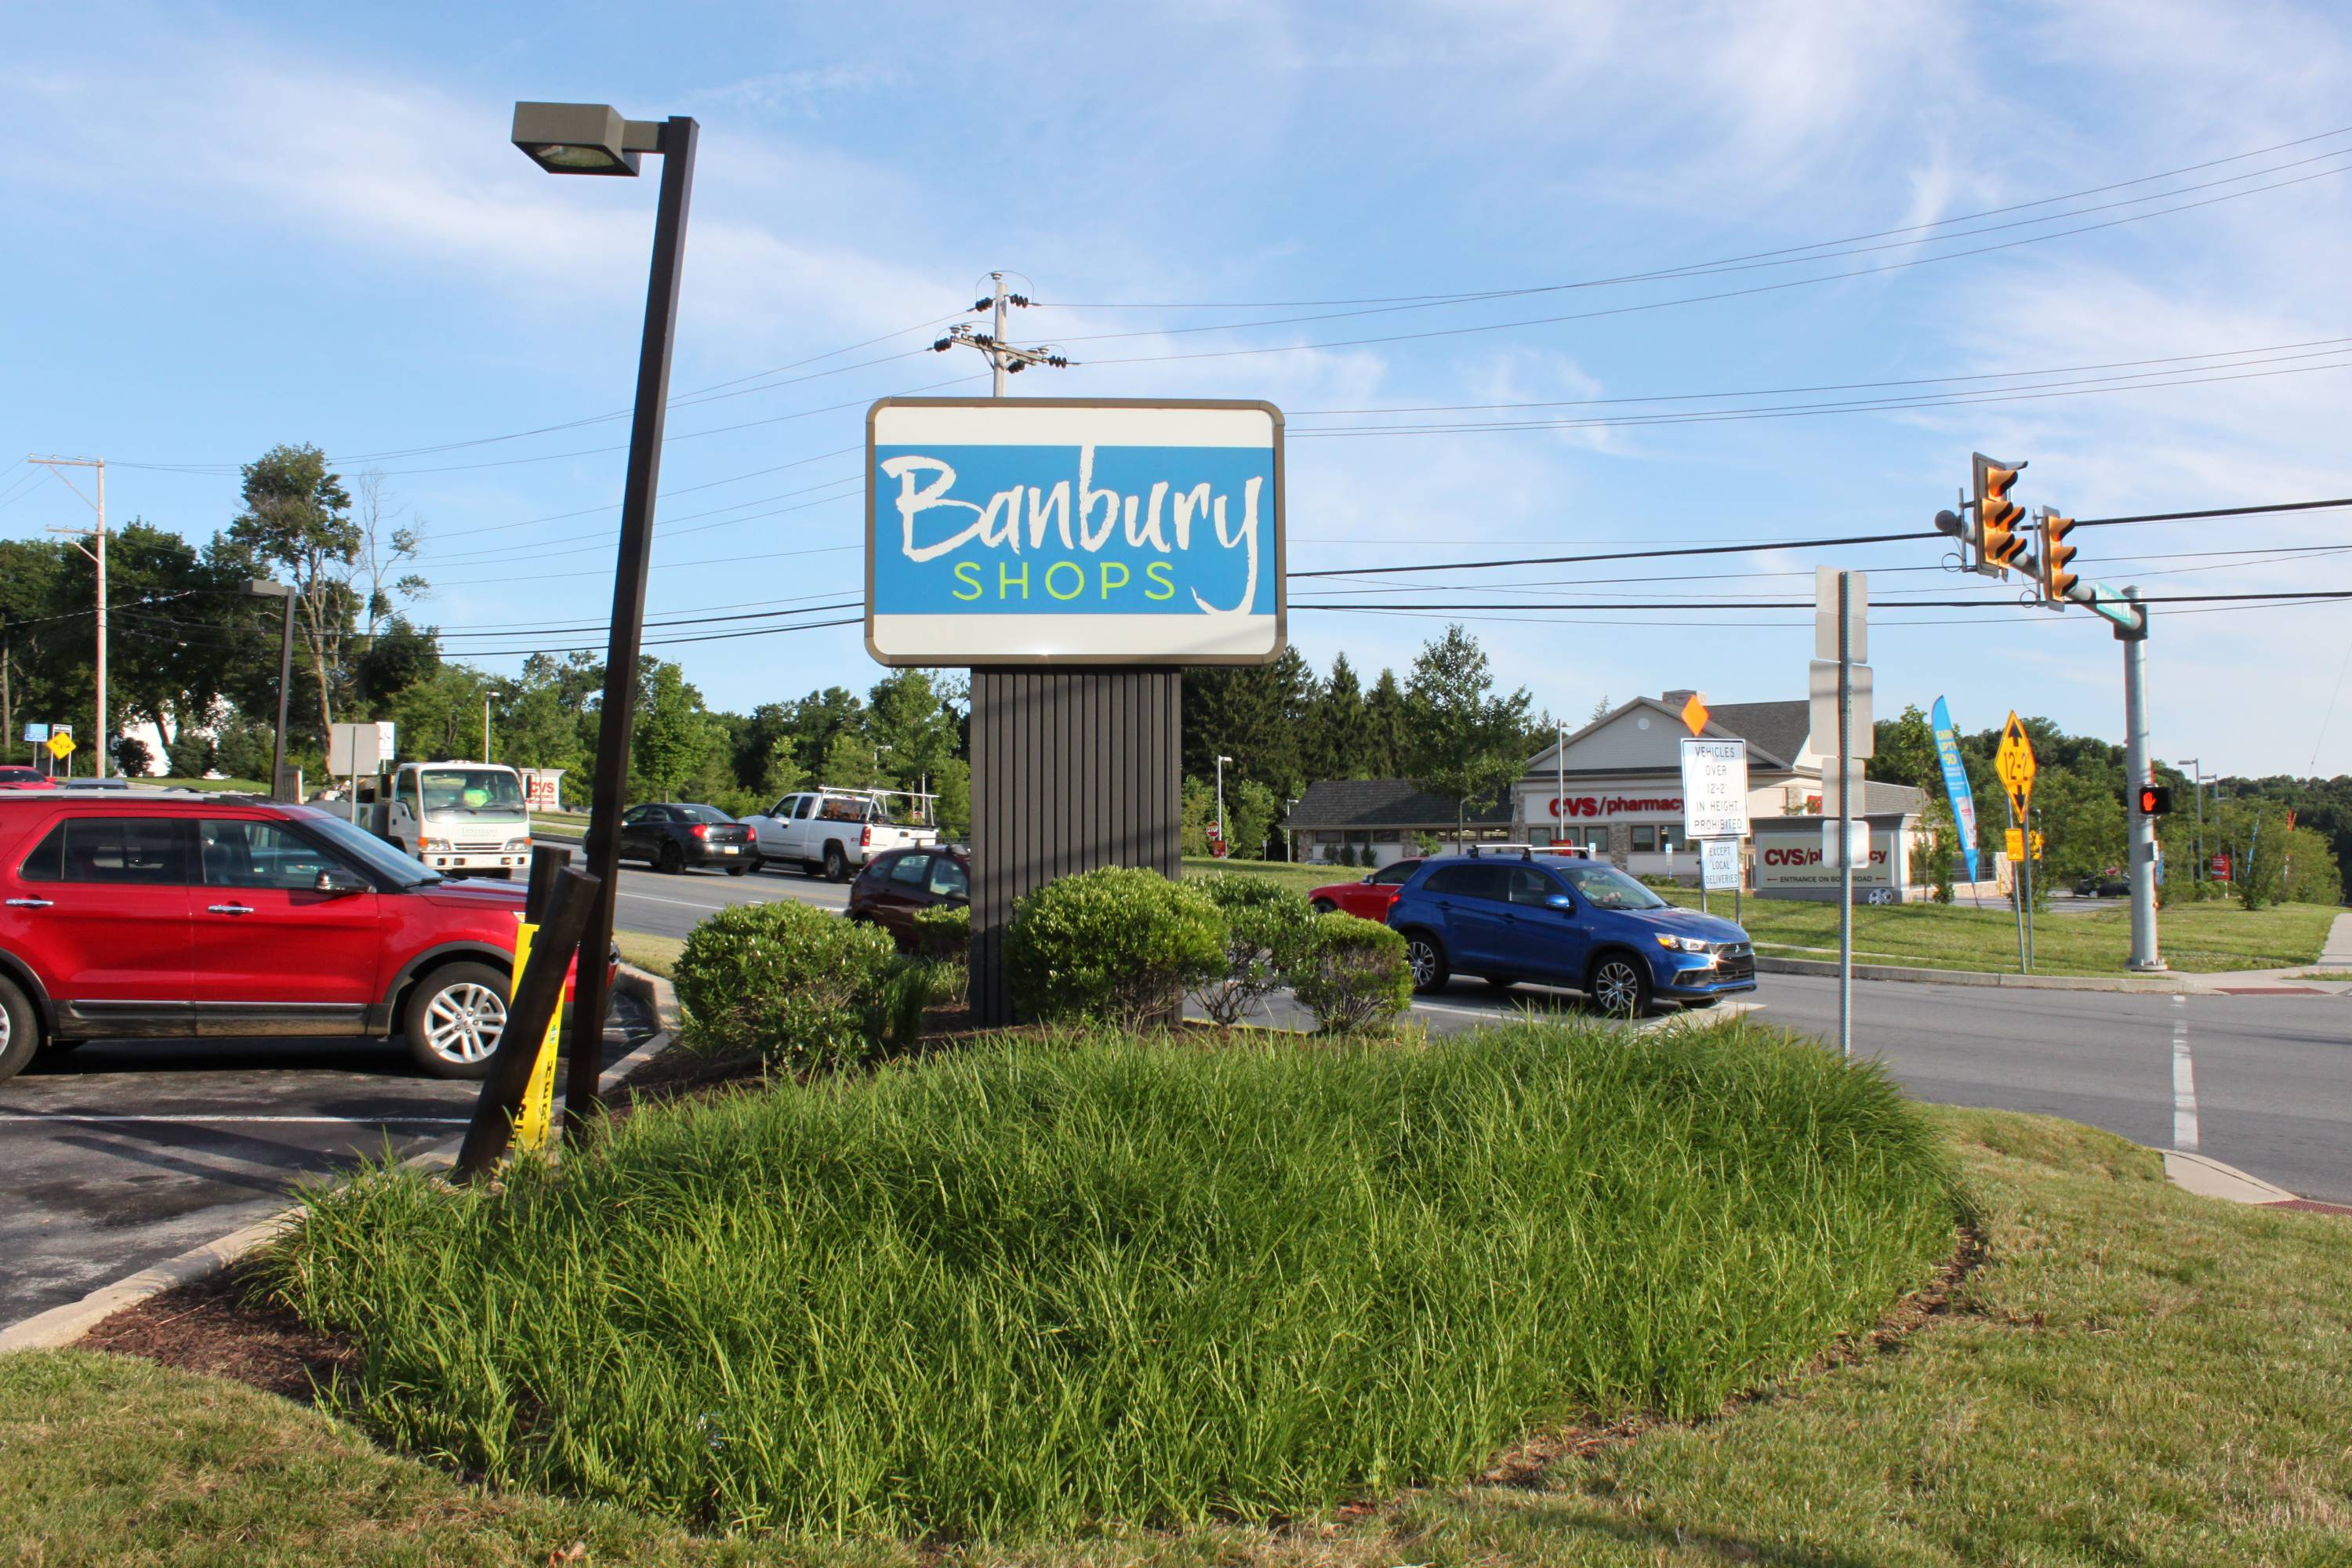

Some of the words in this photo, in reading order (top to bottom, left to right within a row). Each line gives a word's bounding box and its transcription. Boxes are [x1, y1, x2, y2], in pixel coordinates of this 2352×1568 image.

[880, 445, 1263, 615] Banbury
[952, 561, 1175, 601] SHOPS
[1695, 746, 1735, 758] VEHICLES
[1705, 765, 1726, 775] OVER
[1697, 801, 1705, 811] IN
[1711, 800, 1738, 811] HEIGHT
[1694, 818, 1742, 830] PROHIBITED
[1709, 847, 1730, 856] EXCEPT
[1765, 848, 1887, 866] CVS/pcy
[1705, 874, 1738, 884] DELIVERIES
